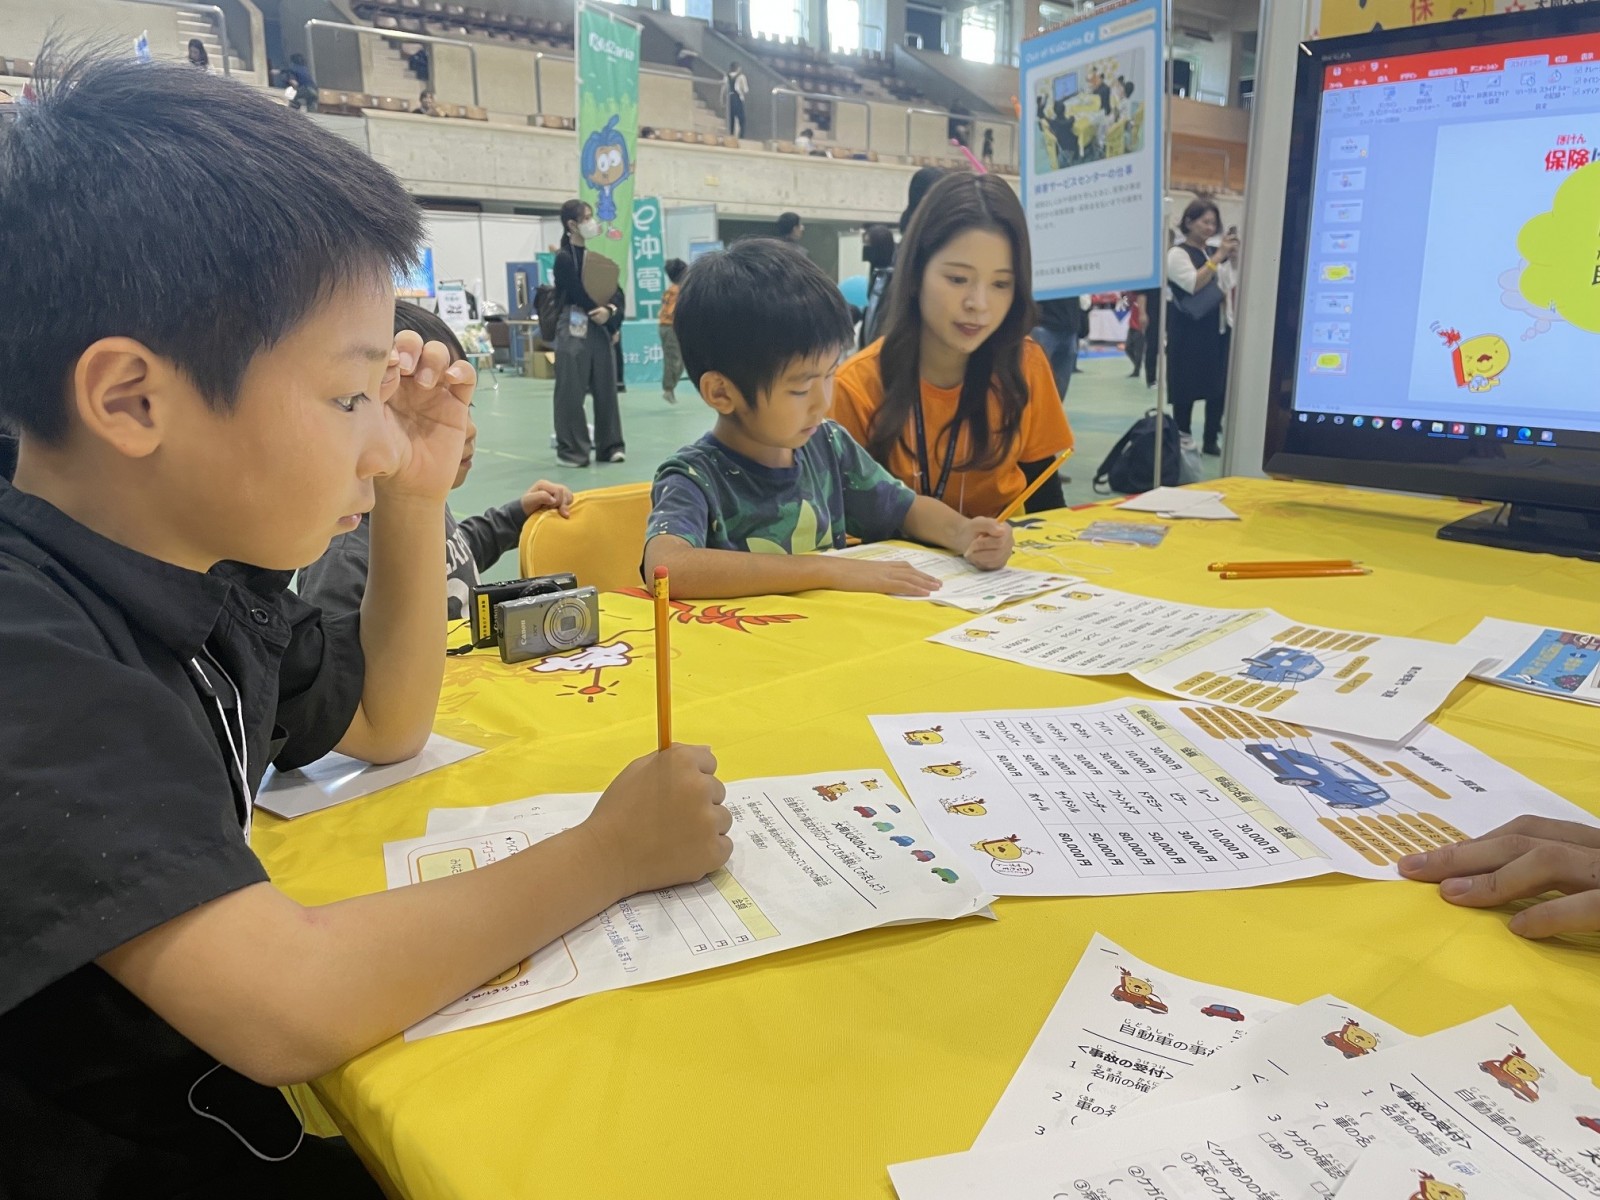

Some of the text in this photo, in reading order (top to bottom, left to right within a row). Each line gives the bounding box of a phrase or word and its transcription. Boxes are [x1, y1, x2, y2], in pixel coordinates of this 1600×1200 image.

[1099, 750, 1130, 776] 30,000円
[1124, 748, 1157, 775] 10,000円
[1149, 745, 1183, 772] 30,000円
[1058, 831, 1094, 868] 80,000円
[1088, 831, 1125, 868] 50,000円
[1118, 831, 1156, 867] 80,000円
[1148, 831, 1187, 865] 50,000円
[1177, 829, 1219, 864] 30,000円
[1207, 827, 1250, 862] 10,000円
[1236, 822, 1281, 856] 30,000円
[694, 943, 708, 952] 円
[715, 939, 729, 948] 円
[735, 934, 750, 943] 円
[1051, 1091, 1063, 1102] 2
[1090, 1067, 1157, 1094] 名前の確
[1034, 1125, 1046, 1136] 3
[1314, 1100, 1372, 1149] 2 車の名
[1380, 1103, 1448, 1157] 名前の確認
[1267, 1113, 1347, 1180] 3 ケガの確認
[1180, 1152, 1236, 1200] ①体のケ
